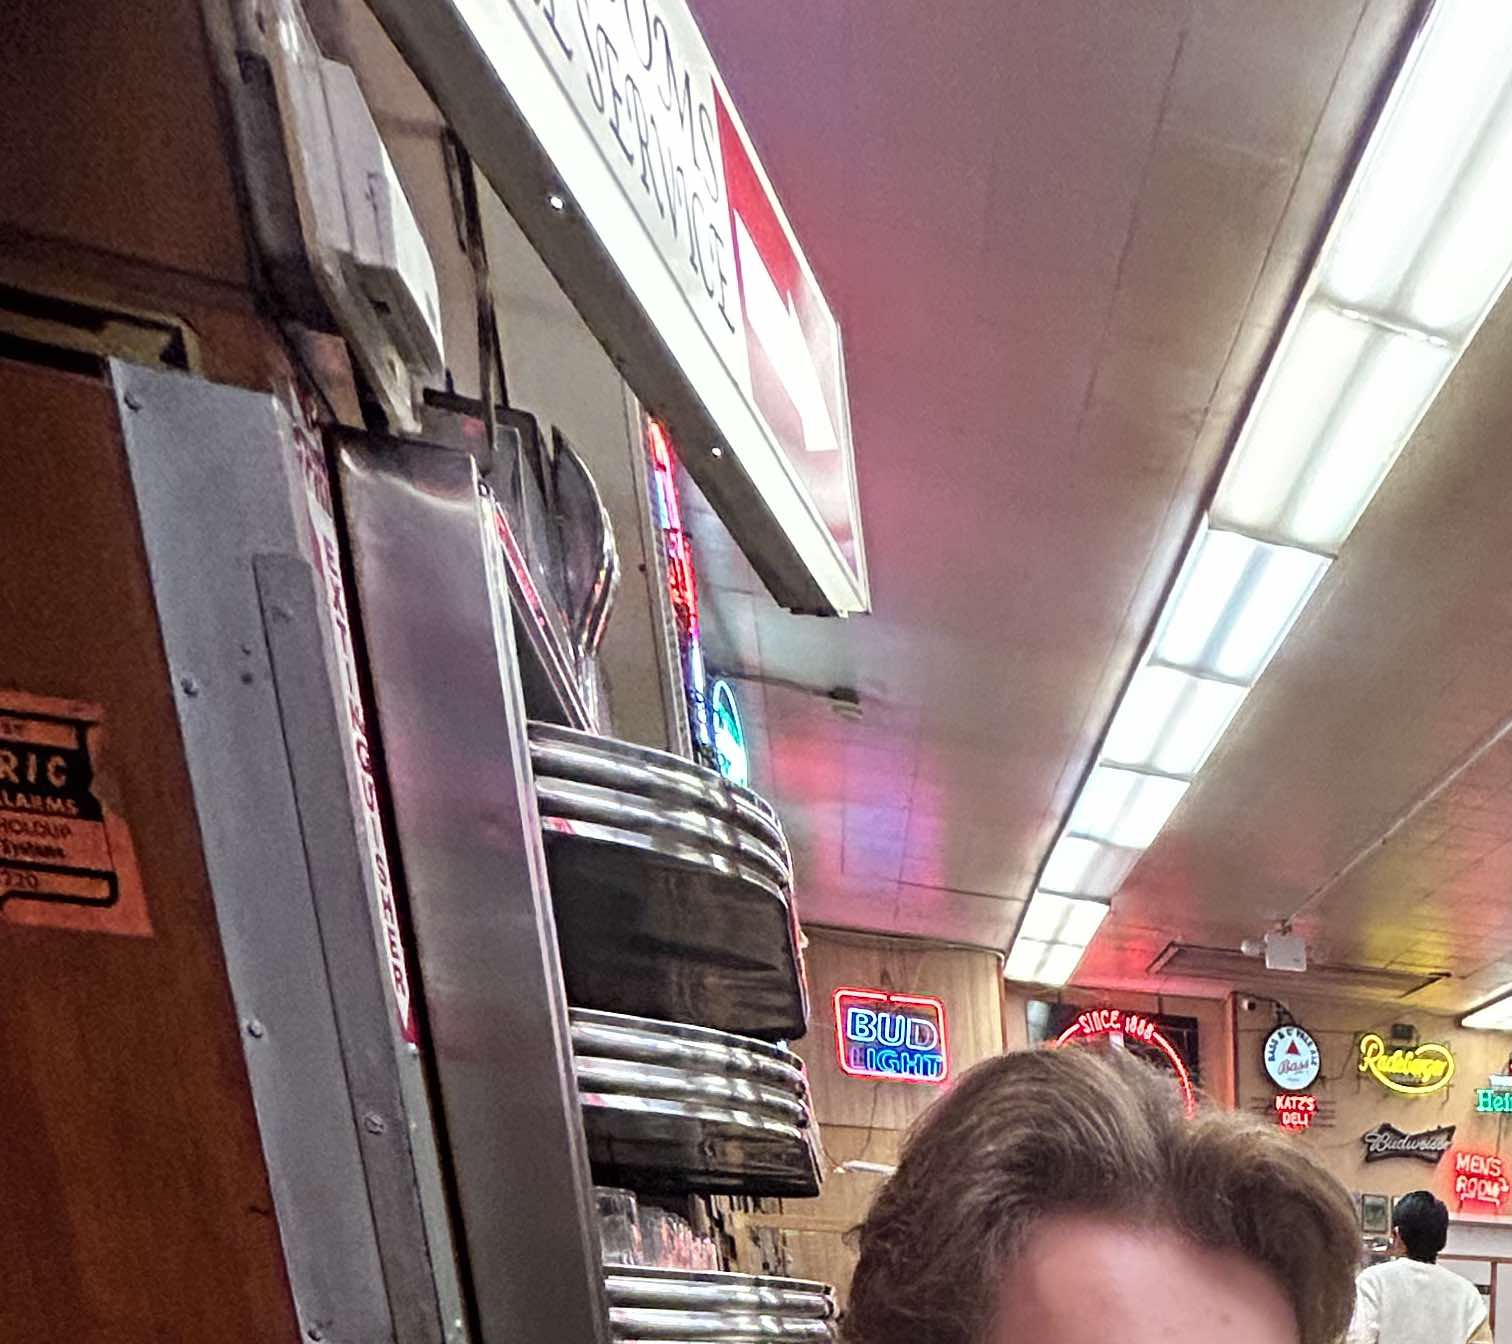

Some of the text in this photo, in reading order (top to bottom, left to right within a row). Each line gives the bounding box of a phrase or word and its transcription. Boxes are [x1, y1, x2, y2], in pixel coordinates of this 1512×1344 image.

[846, 1007, 939, 1051] BUD
[1078, 1009, 1121, 1034] SINCE
[849, 1046, 944, 1079] LIGHT
